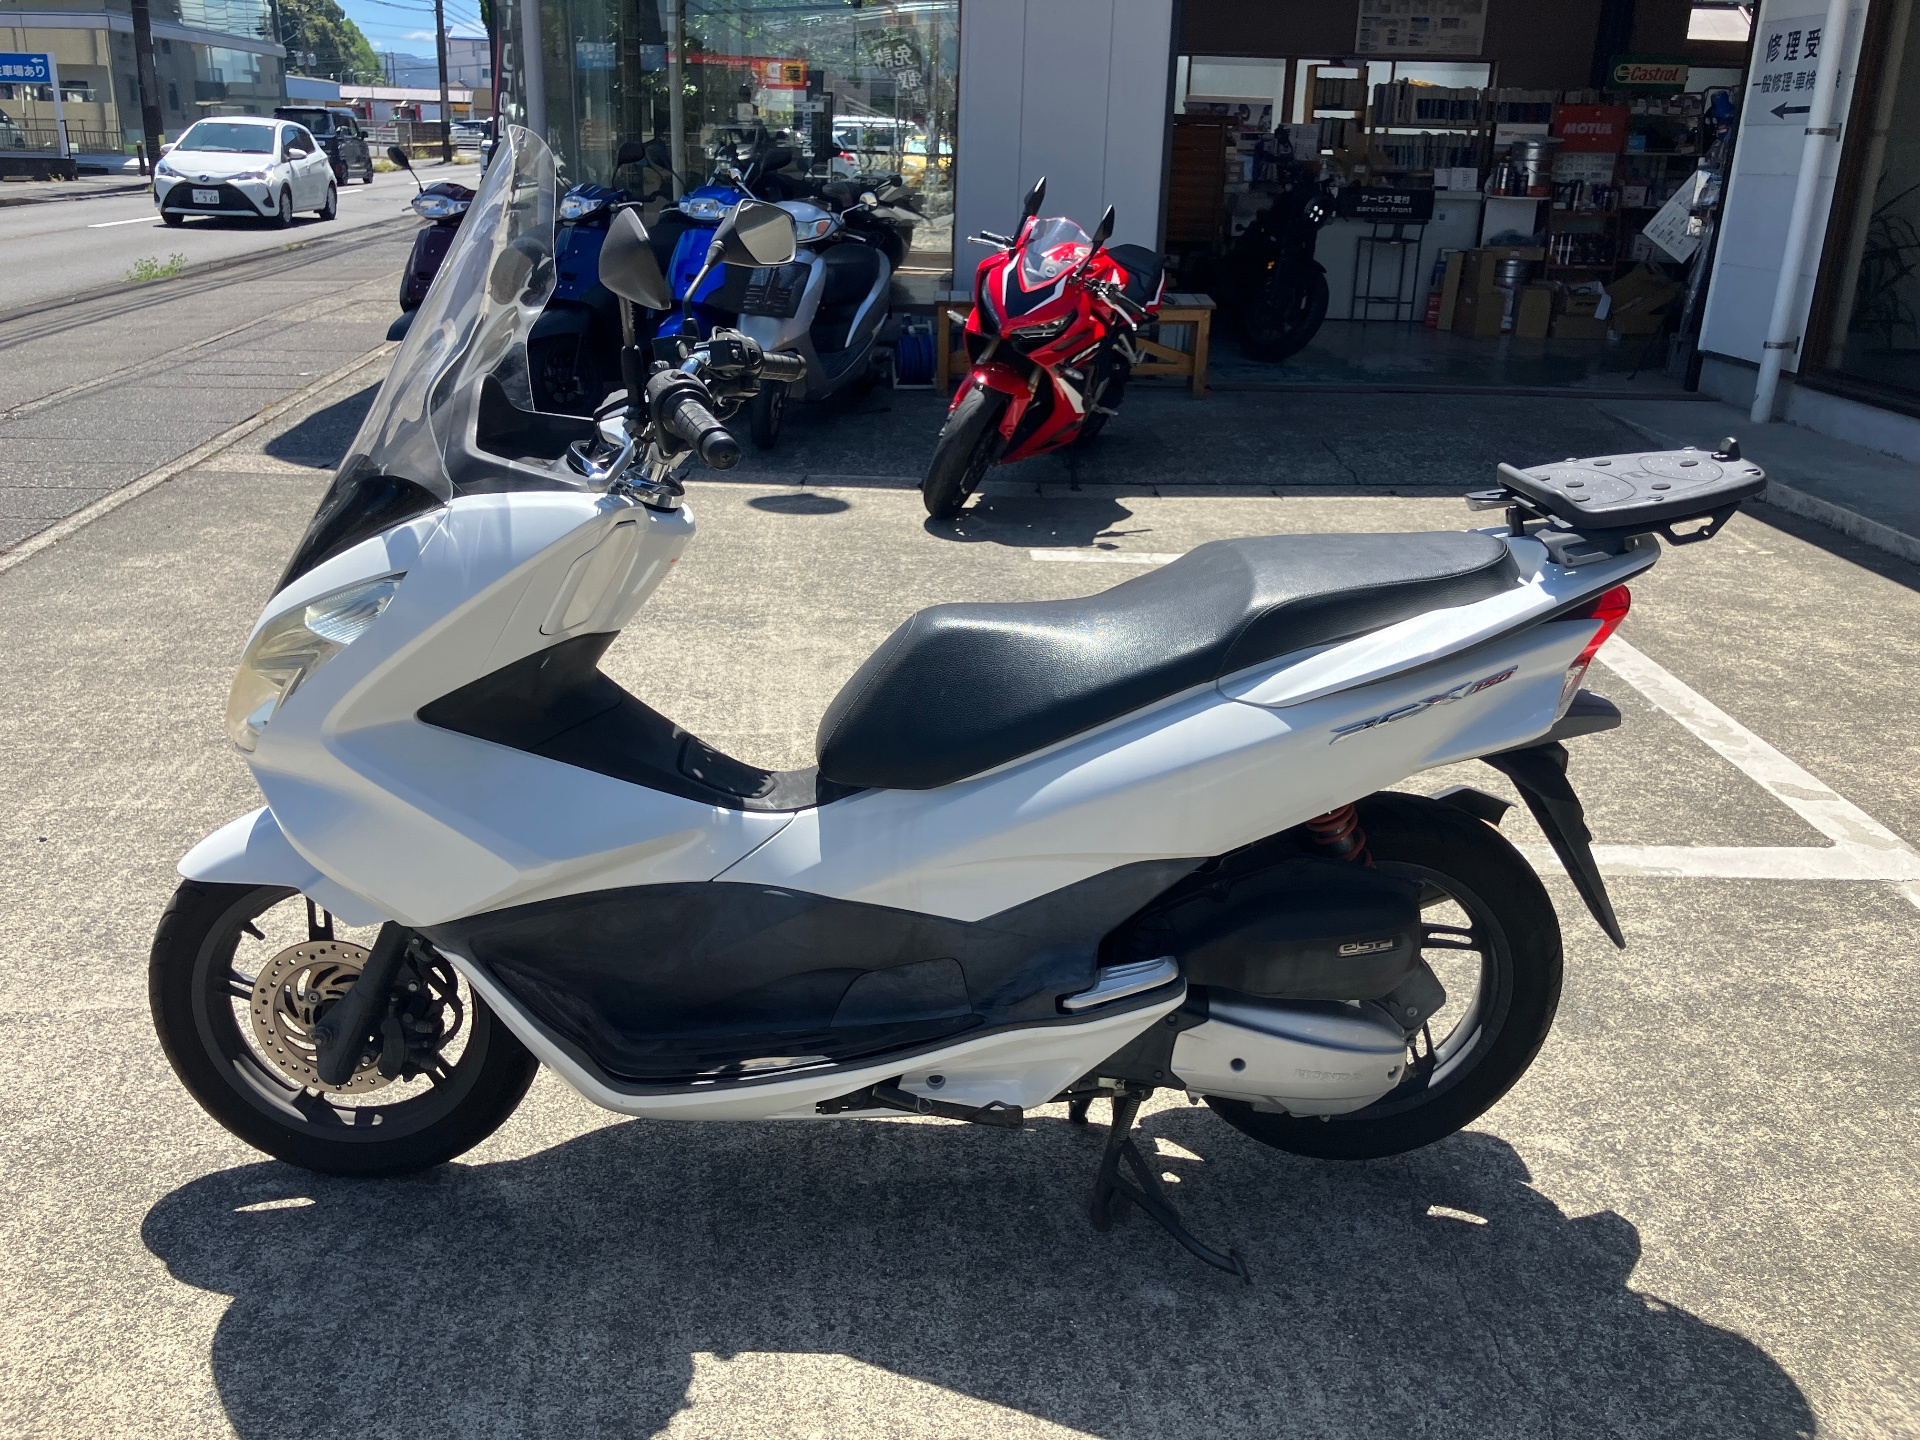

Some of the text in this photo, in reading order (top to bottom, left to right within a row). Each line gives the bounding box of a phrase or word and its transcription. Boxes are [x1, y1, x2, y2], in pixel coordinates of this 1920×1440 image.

[1765, 28, 1821, 63] 修理受
[1631, 66, 1679, 82] Castrol
[1752, 69, 1842, 93] 一般修理・車検
[1562, 122, 1613, 134] MOTUL
[1295, 1068, 1365, 1082] HONDA
